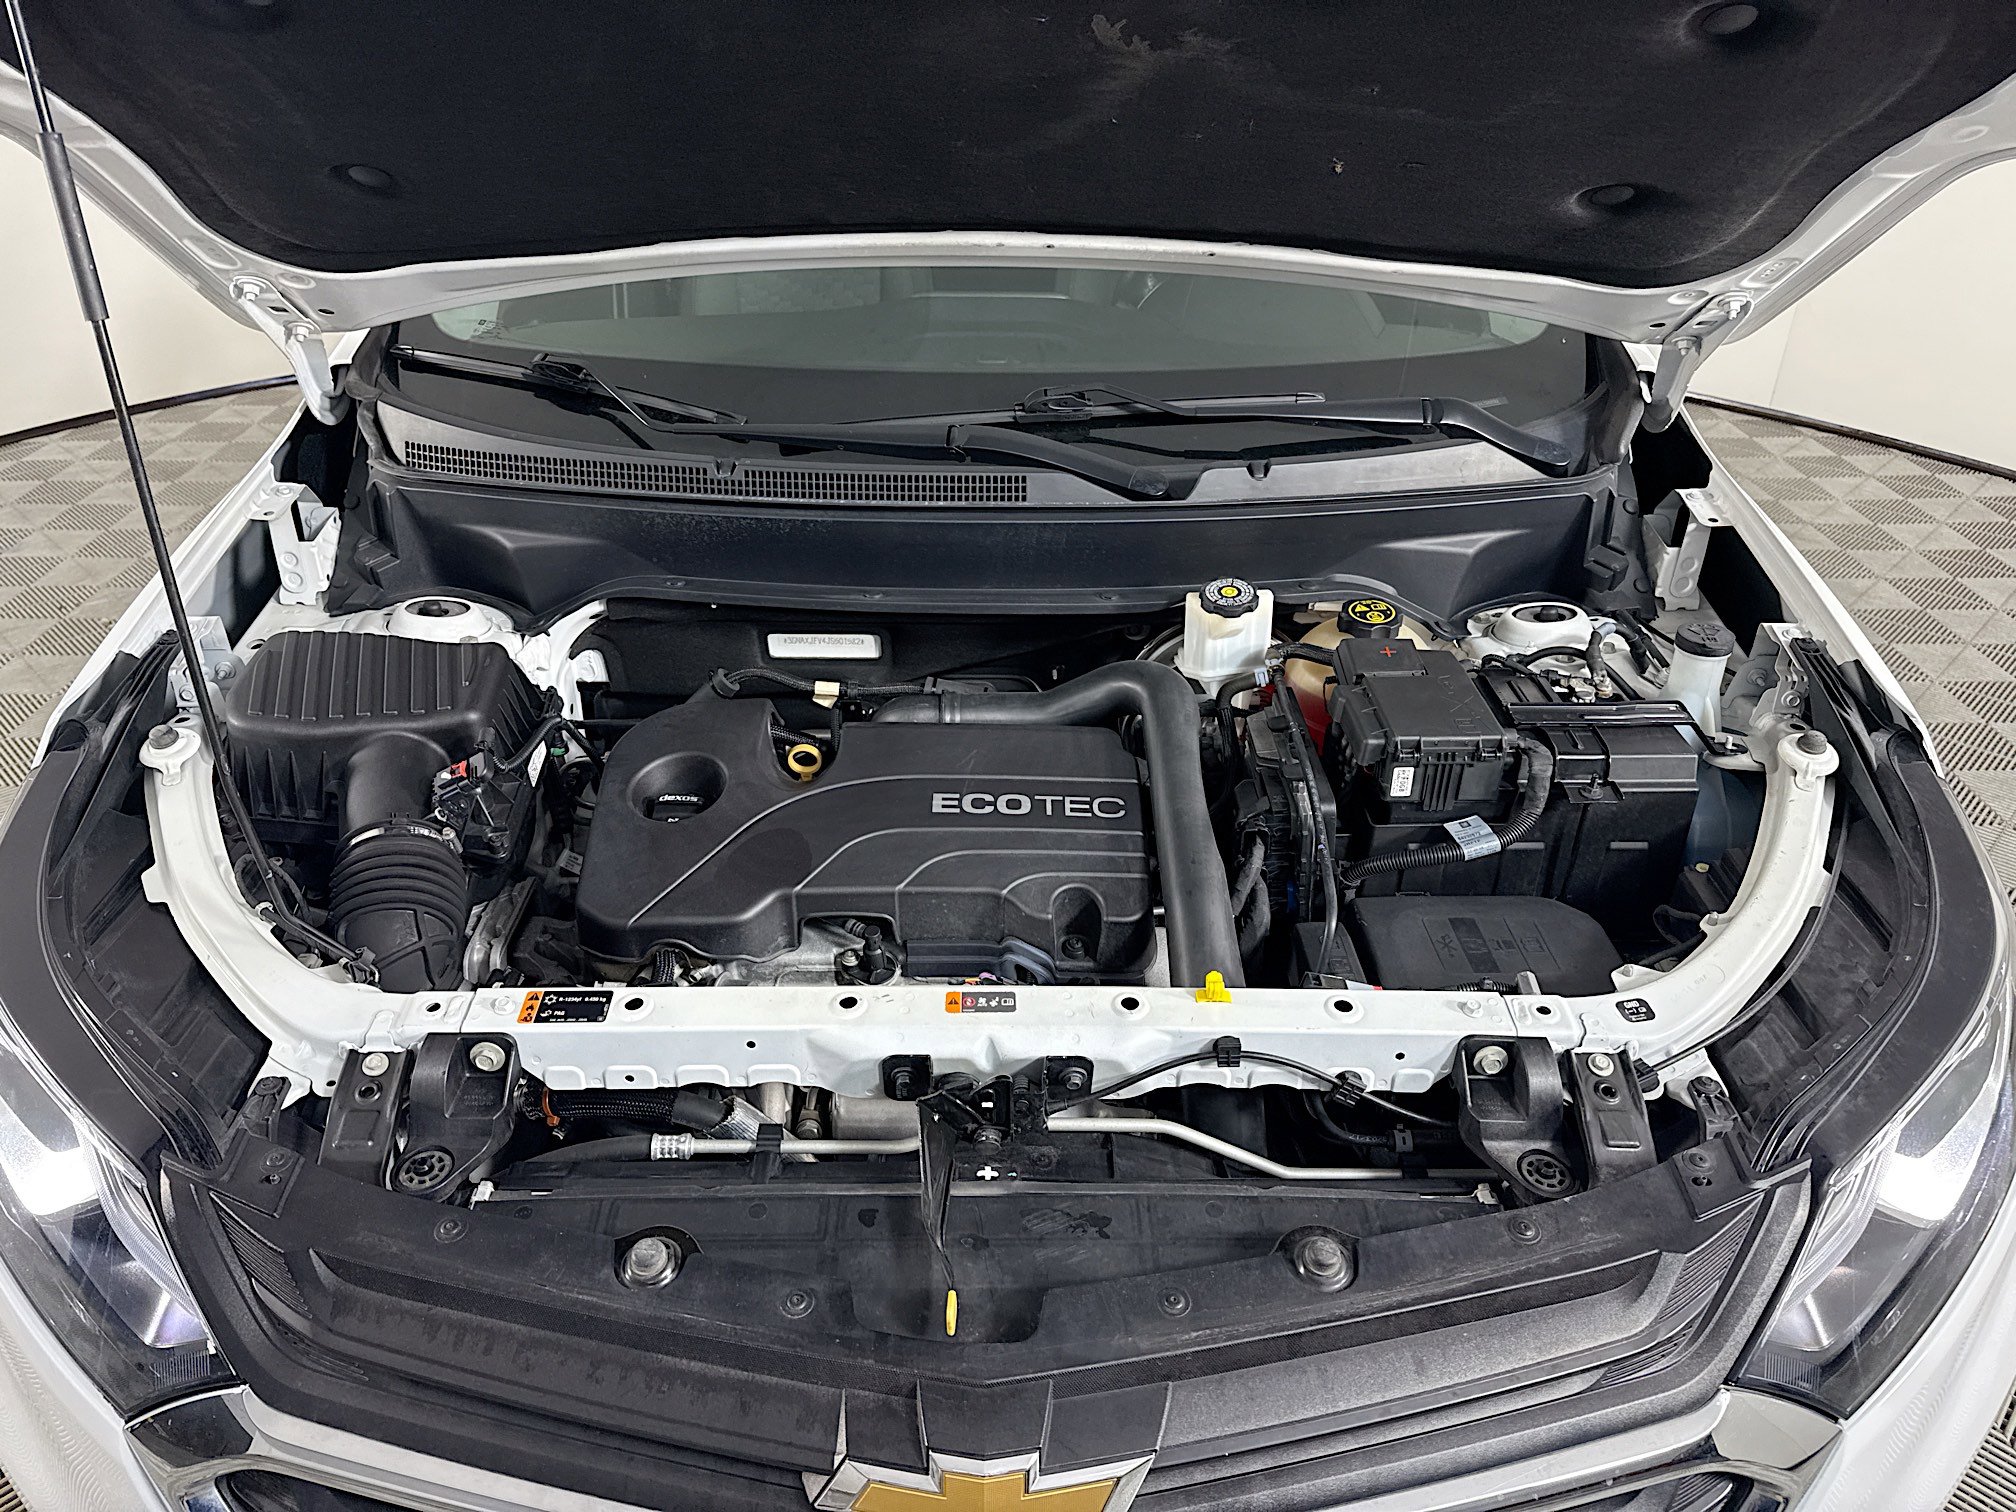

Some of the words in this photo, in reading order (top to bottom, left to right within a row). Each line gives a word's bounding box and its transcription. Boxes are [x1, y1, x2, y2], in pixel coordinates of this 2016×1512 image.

[659, 793, 699, 802] dexos
[931, 792, 1126, 819] ECOTEC
[1623, 1000, 1640, 1009] GND
